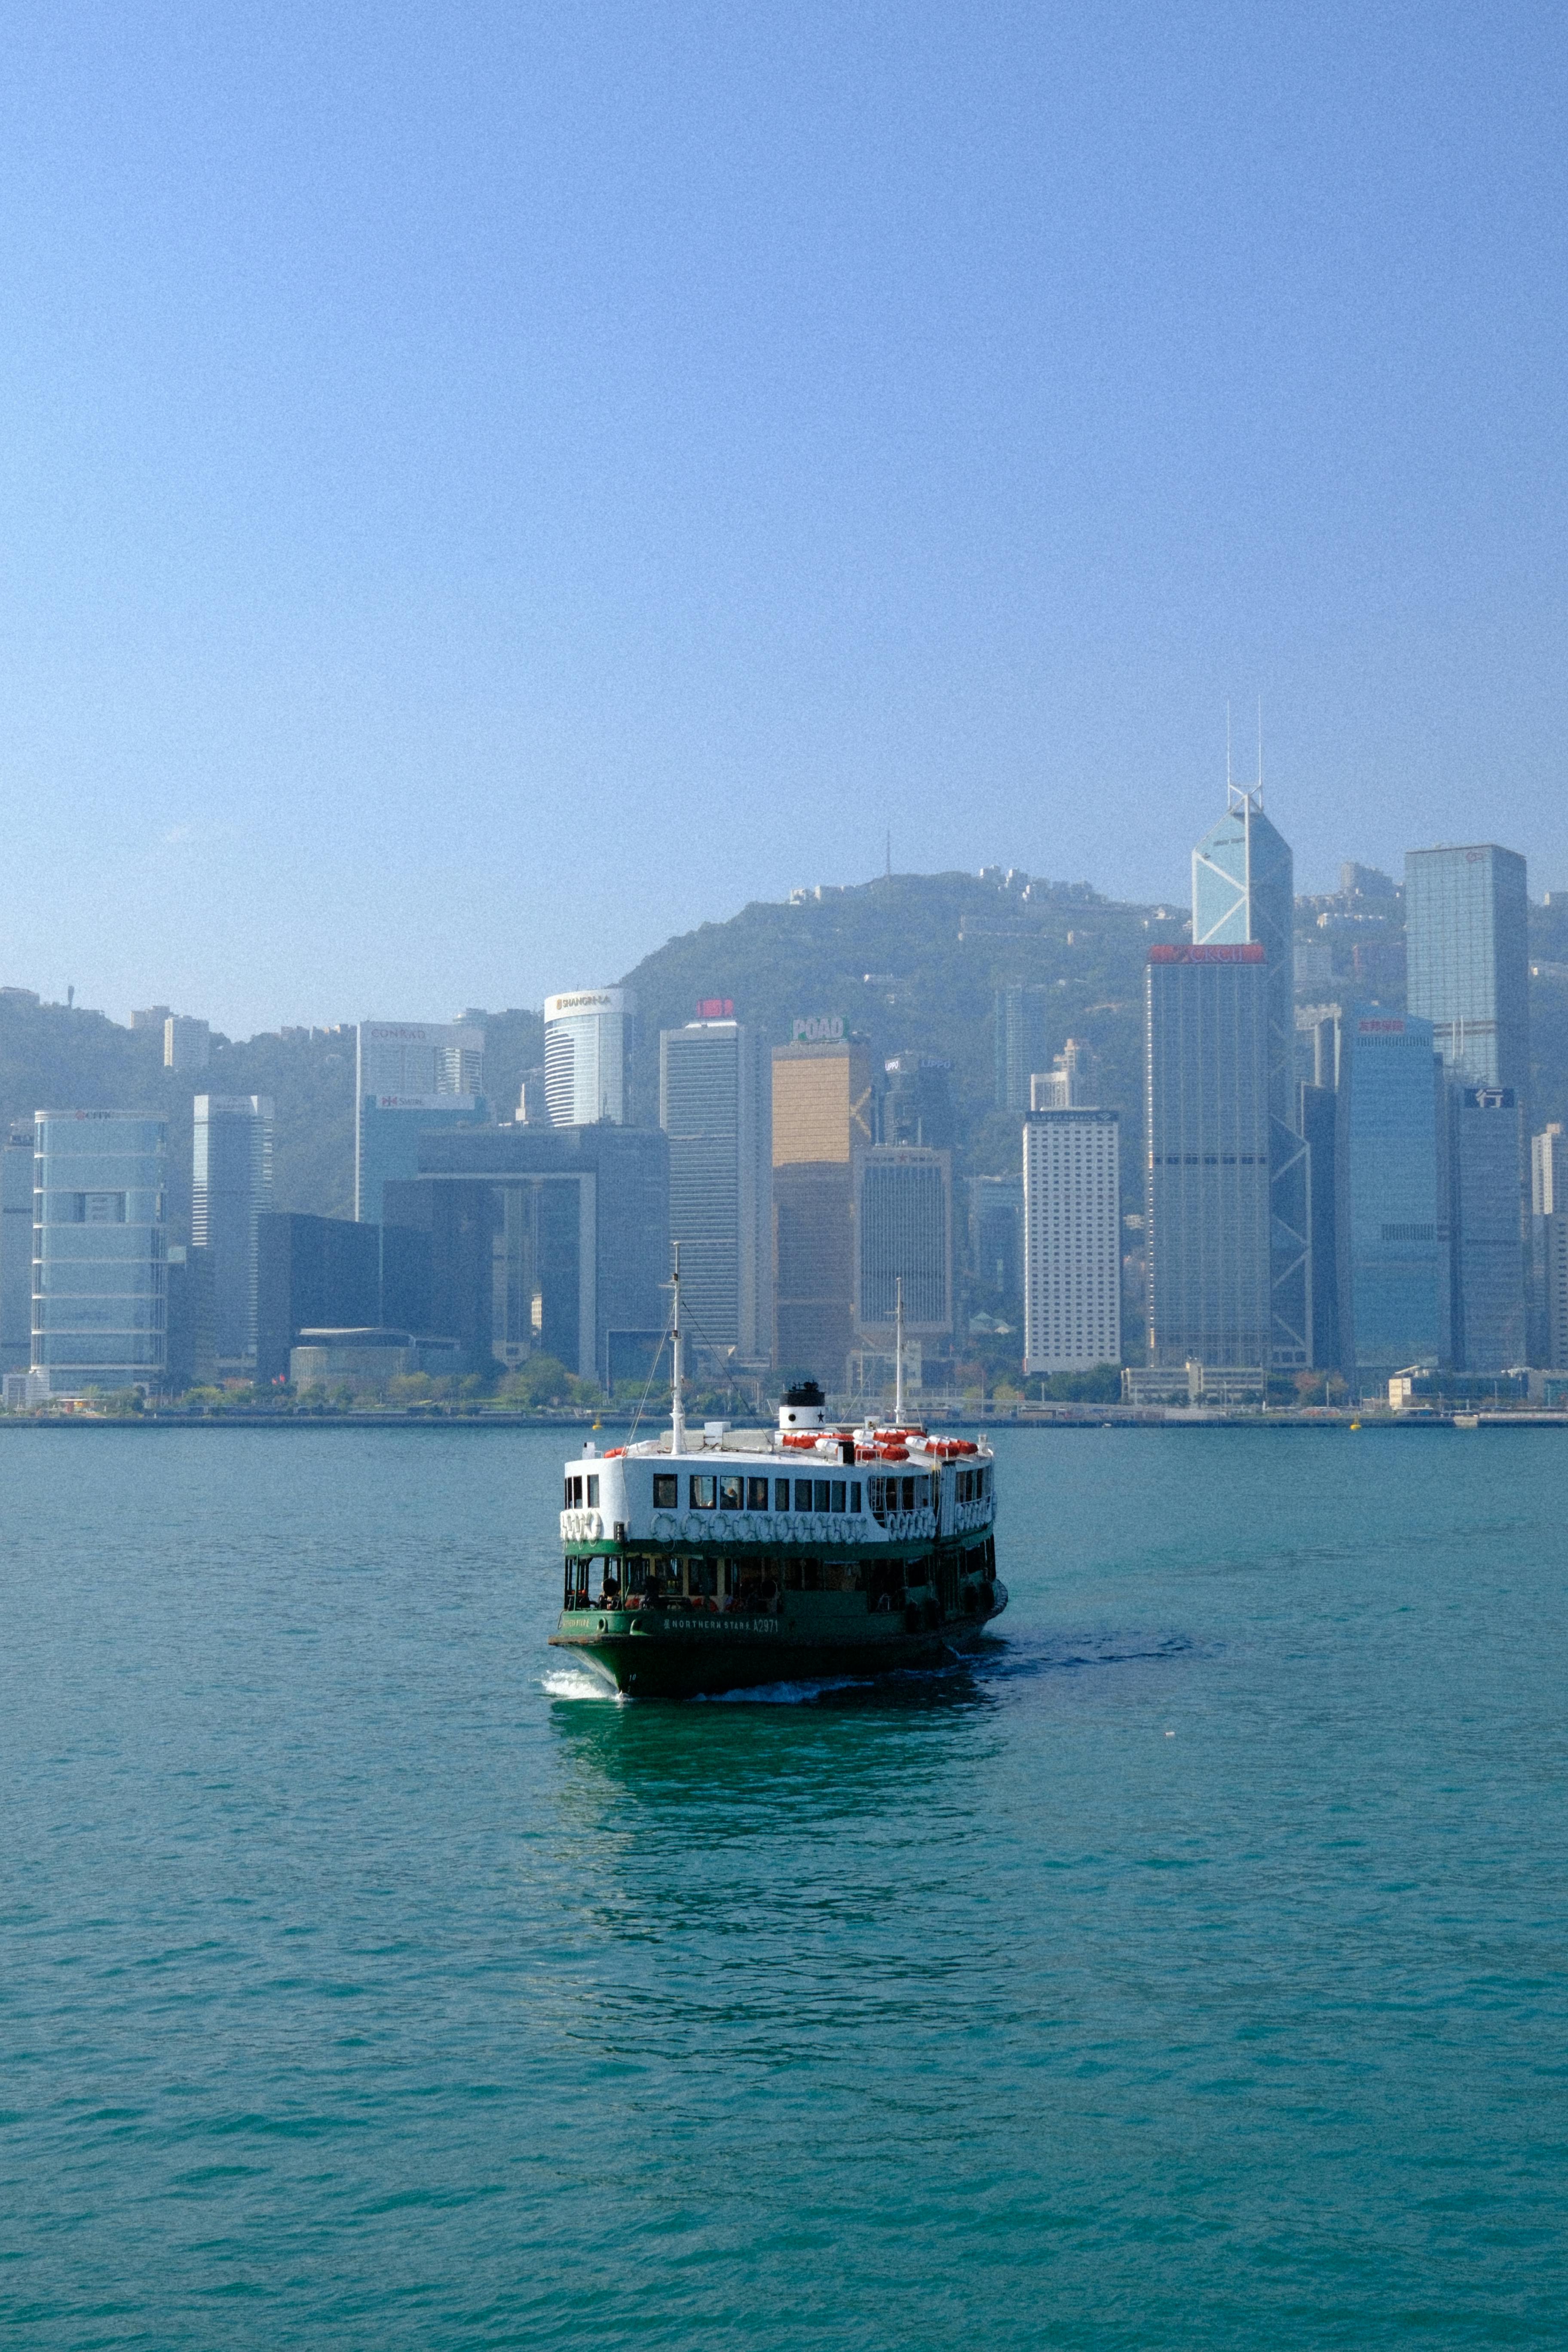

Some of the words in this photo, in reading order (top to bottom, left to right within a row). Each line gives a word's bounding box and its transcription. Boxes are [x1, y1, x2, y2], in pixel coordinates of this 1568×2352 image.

[563, 995, 611, 1008] SHANGRI-LA
[371, 1029, 426, 1039] CONRAD
[793, 1017, 844, 1040] POAD
[885, 1060, 899, 1071] LIPPO
[921, 1059, 951, 1069] LIPPO
[672, 1620, 721, 1629] NORTHERN
[724, 1621, 744, 1629] STAR
[753, 1619, 778, 1632] A2971
[629, 1673, 636, 1681] 10
